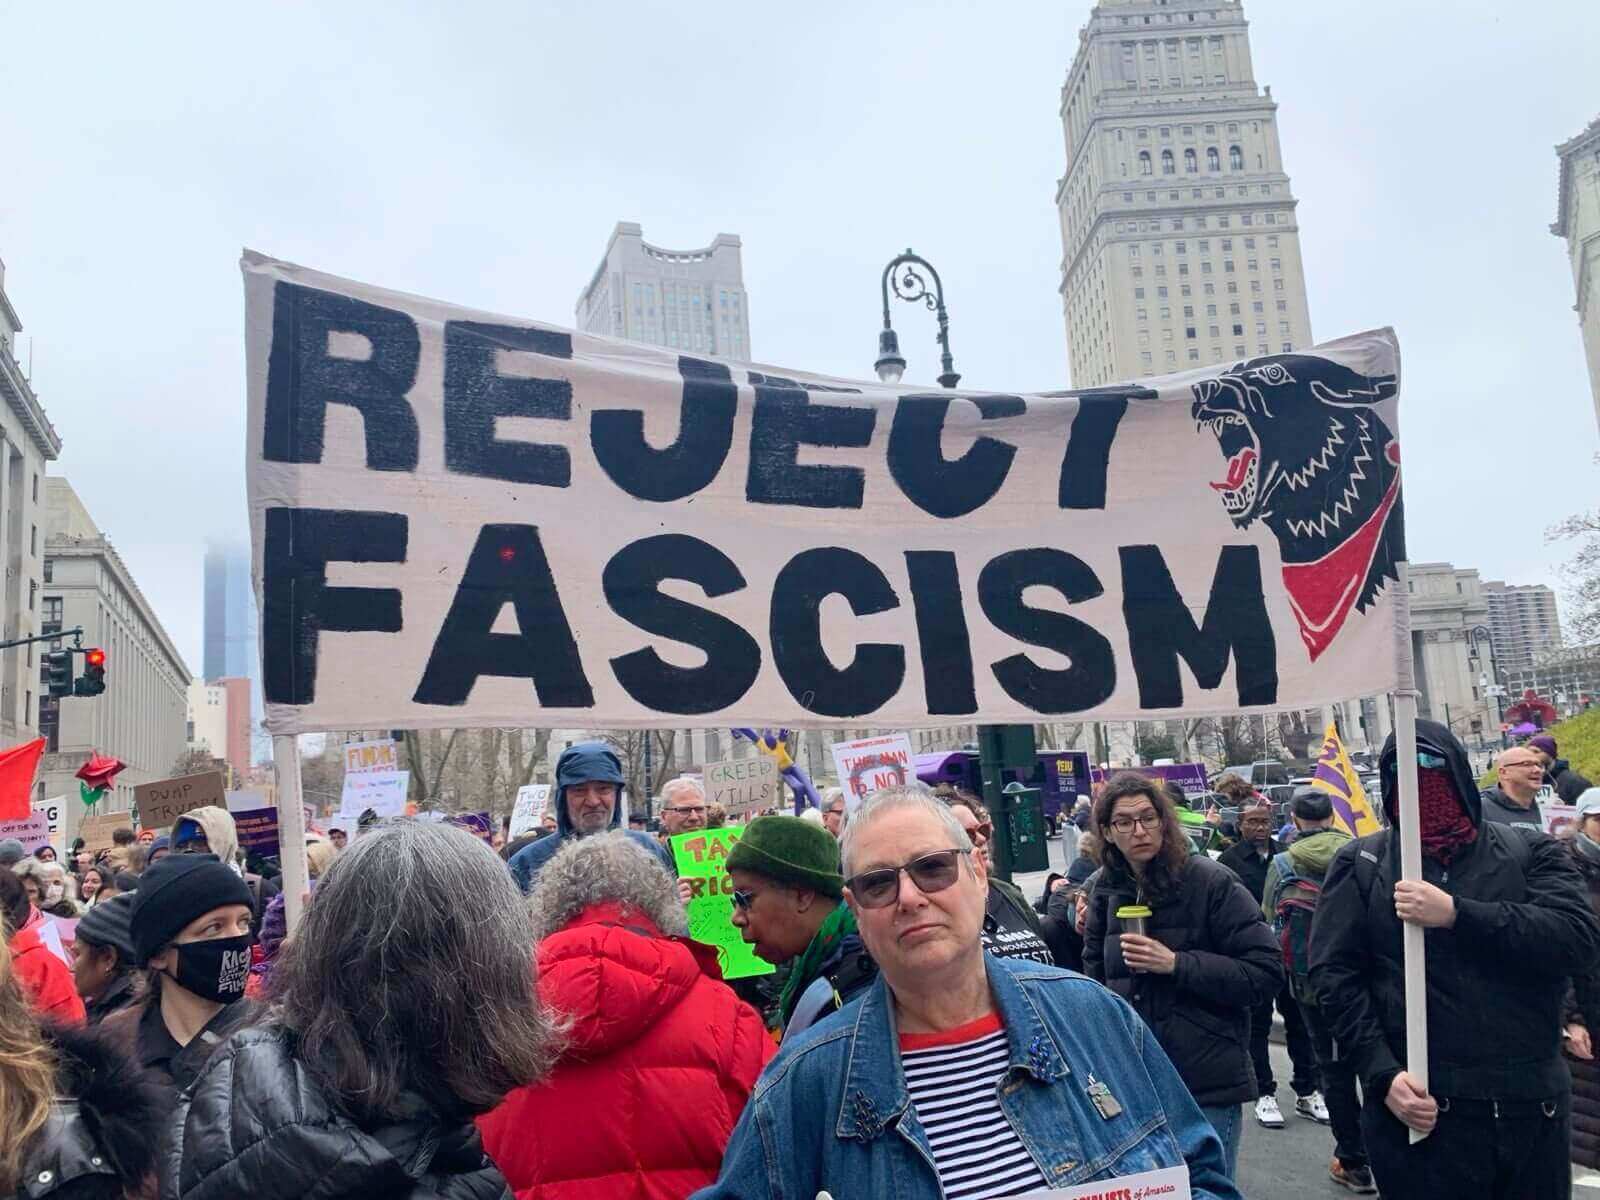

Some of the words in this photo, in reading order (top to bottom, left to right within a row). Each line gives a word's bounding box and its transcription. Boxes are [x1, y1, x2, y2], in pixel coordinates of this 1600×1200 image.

[263, 281, 1159, 518] REJECT
[263, 507, 1278, 716] FASCISM
[711, 762, 771, 782] GREED
[149, 784, 193, 801] DUMP
[690, 874, 734, 898] RIC
[1000, 942, 1028, 953] would
[1133, 1189, 1143, 1199] of
[1143, 1184, 1175, 1197] America
